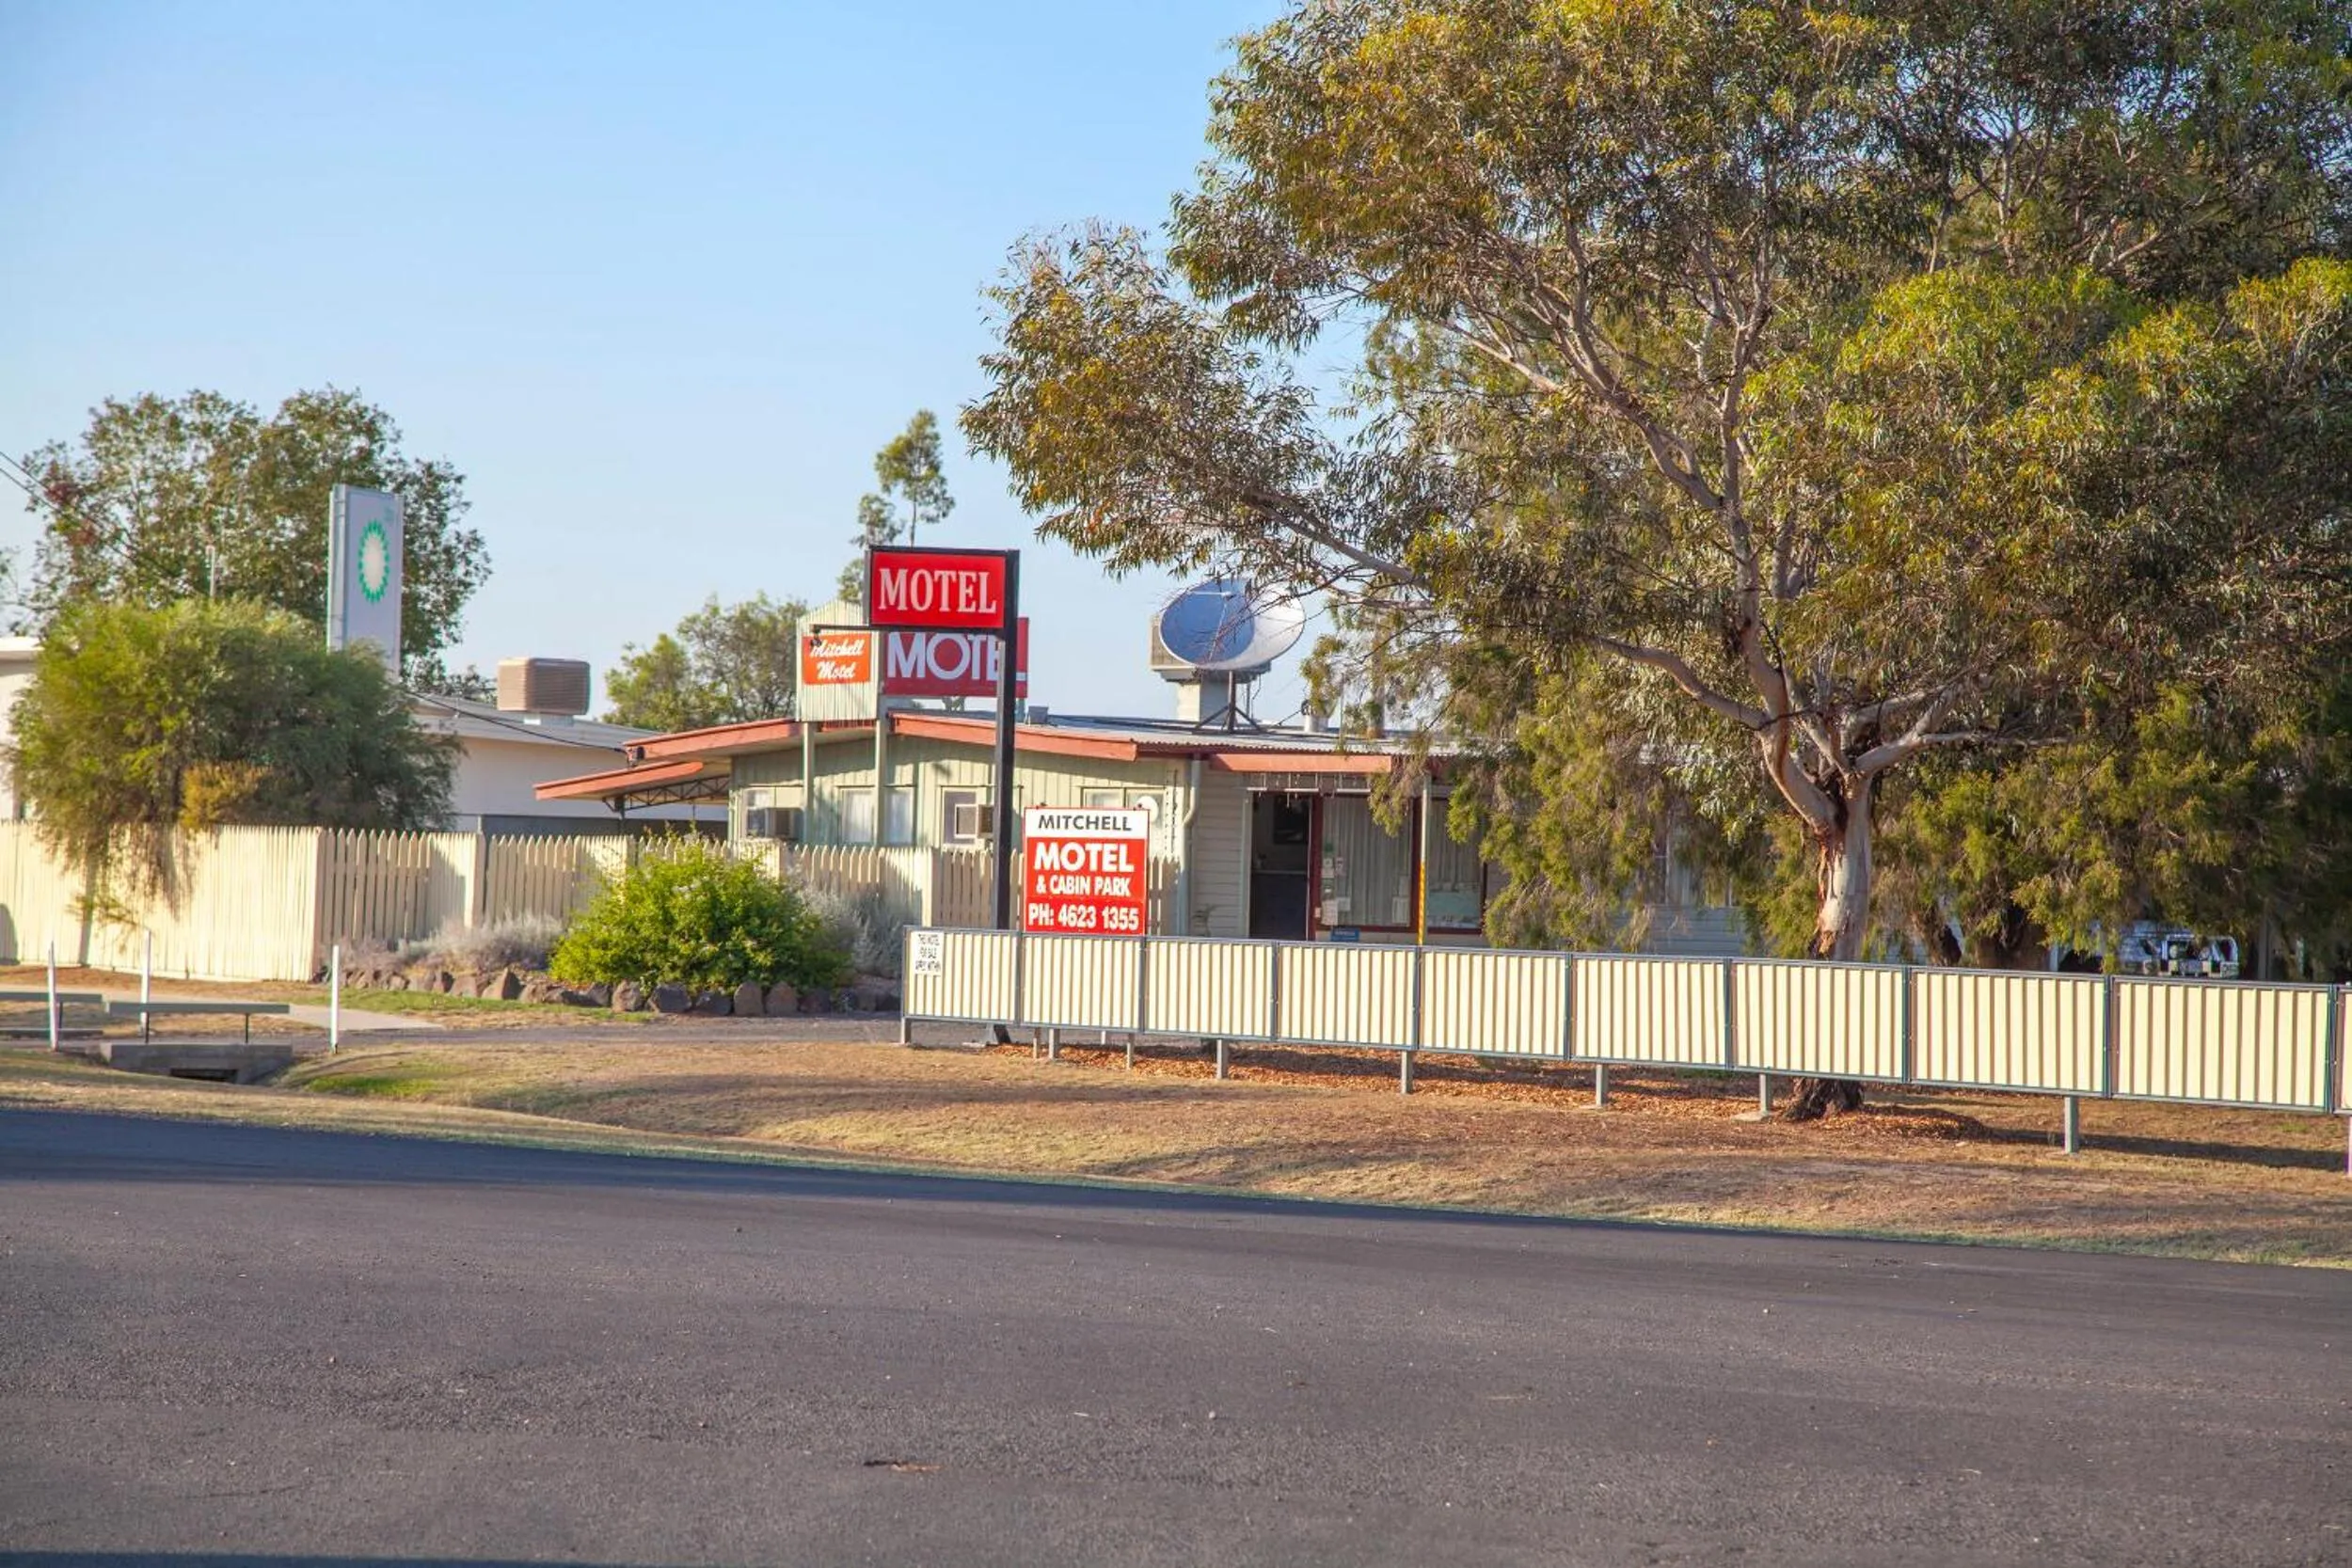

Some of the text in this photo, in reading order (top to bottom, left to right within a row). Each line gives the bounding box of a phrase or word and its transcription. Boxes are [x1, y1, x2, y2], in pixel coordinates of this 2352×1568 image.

[878, 567, 997, 614] MOTEL
[817, 661, 857, 680] Motel
[886, 631, 1028, 682] MOTE
[1038, 815, 1133, 832] MITCHELL
[1034, 842, 1135, 873] MOTEL
[1036, 875, 1132, 897] & CABIN PARK
[1027, 902, 1139, 931] PH: 4623 1355
